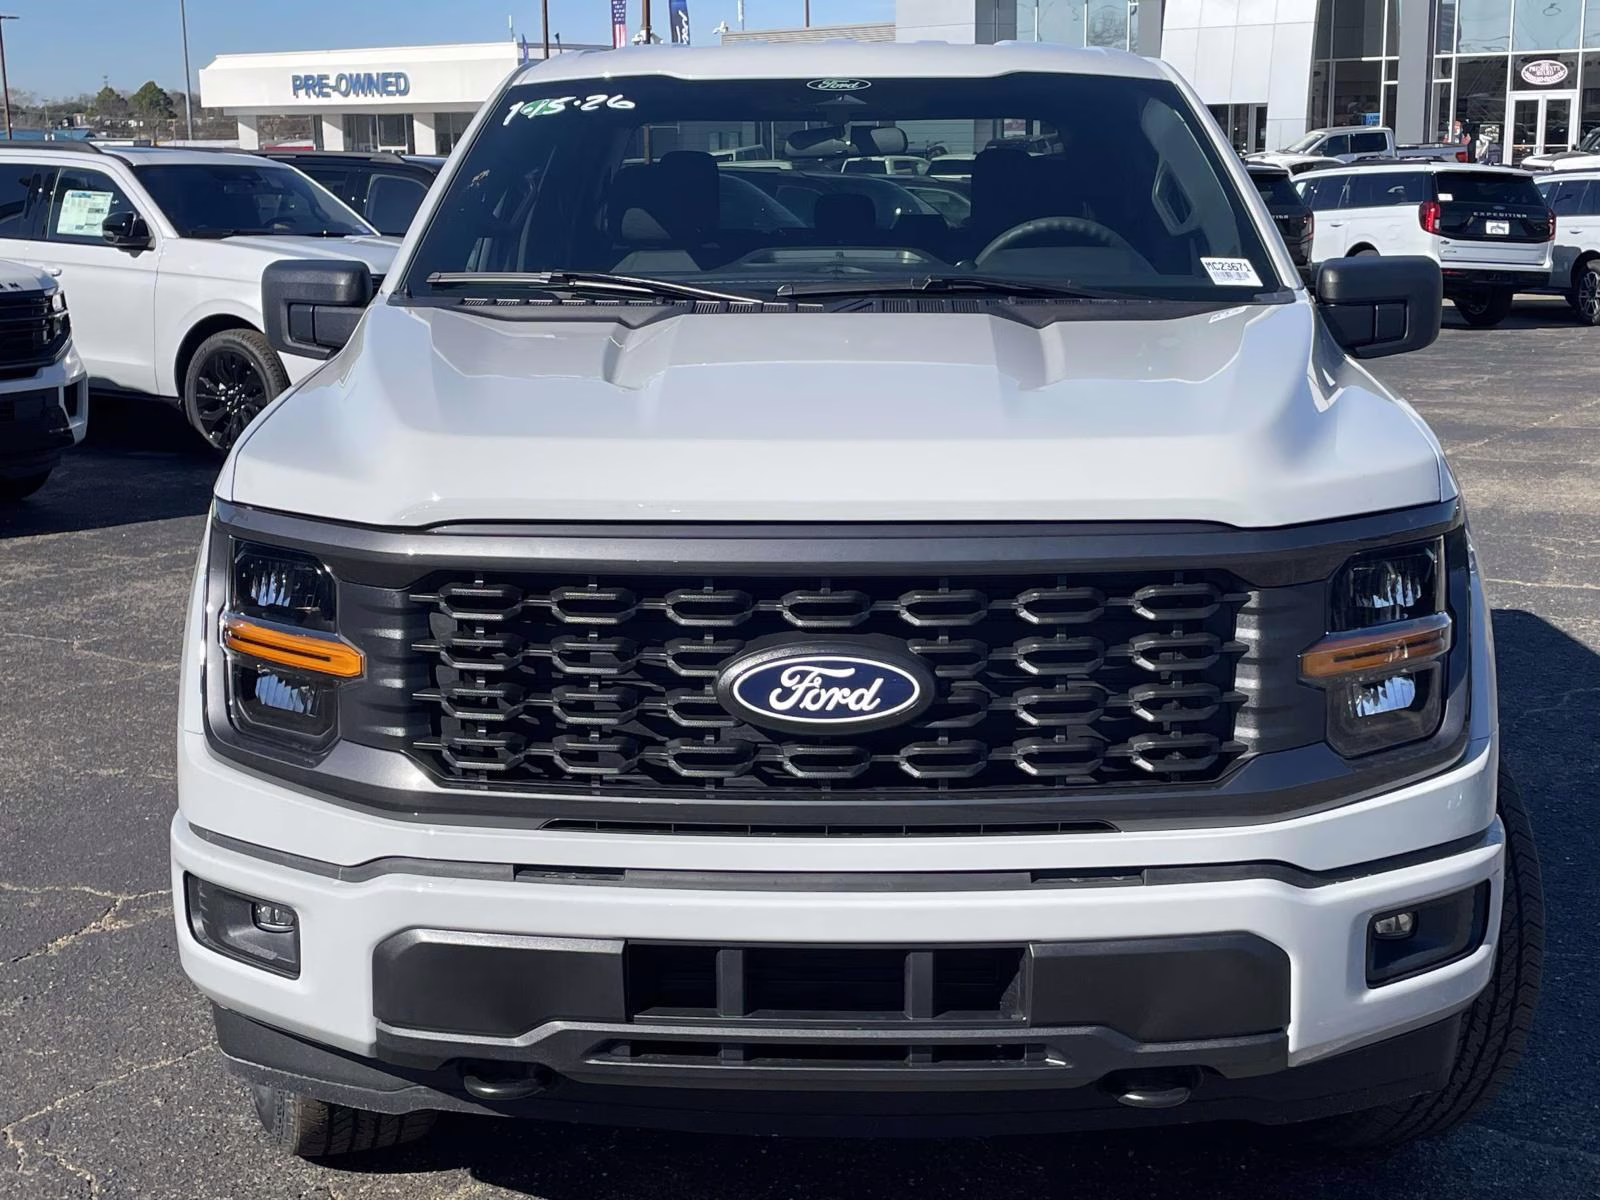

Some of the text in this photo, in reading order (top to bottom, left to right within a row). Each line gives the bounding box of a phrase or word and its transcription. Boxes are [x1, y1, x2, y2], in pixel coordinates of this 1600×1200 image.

[292, 72, 410, 98] PRE-OWNED
[818, 79, 860, 89] Ford
[1205, 261, 1251, 272] MC23671
[769, 665, 884, 711] Ford
